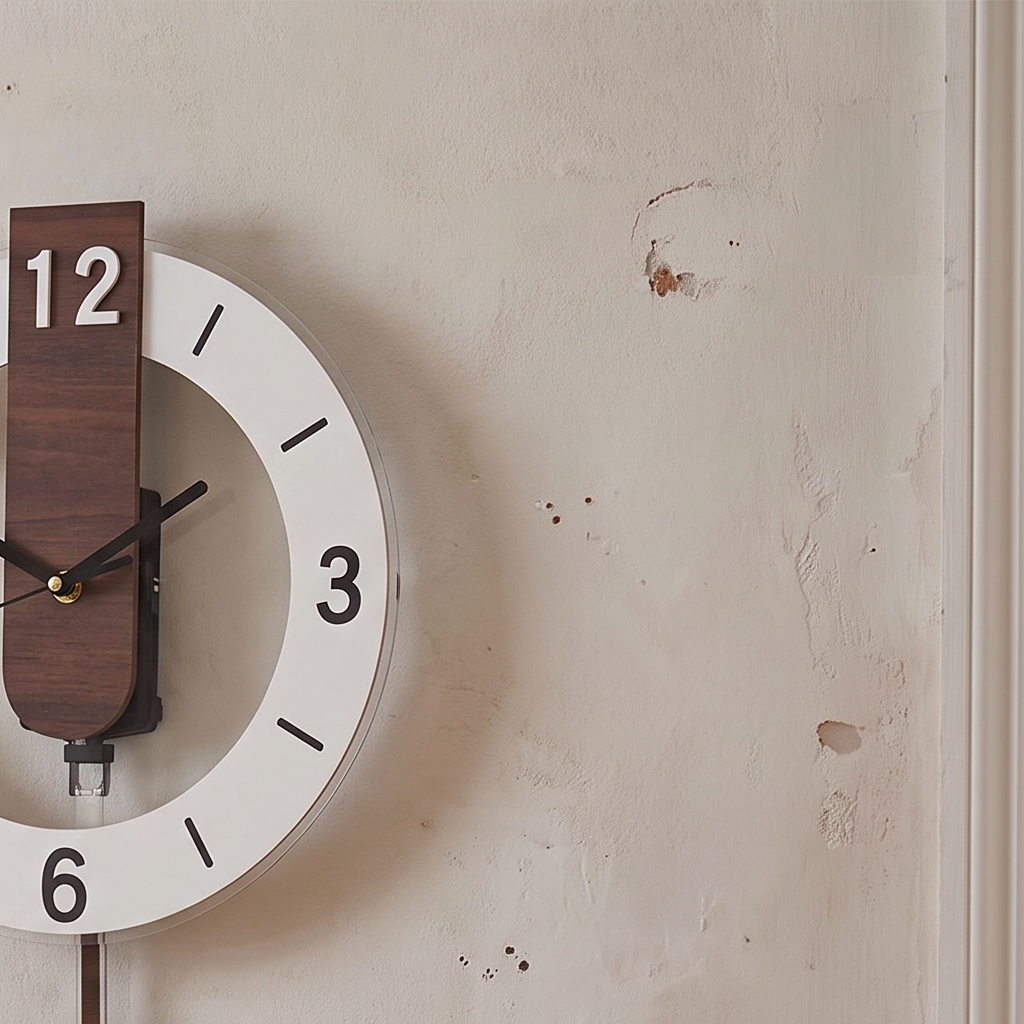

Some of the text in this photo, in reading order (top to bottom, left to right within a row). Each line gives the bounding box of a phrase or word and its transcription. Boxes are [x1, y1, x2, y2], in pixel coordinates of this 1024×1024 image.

[27, 246, 121, 328] 12
[316, 545, 362, 625] 3
[41, 847, 88, 924] 6
